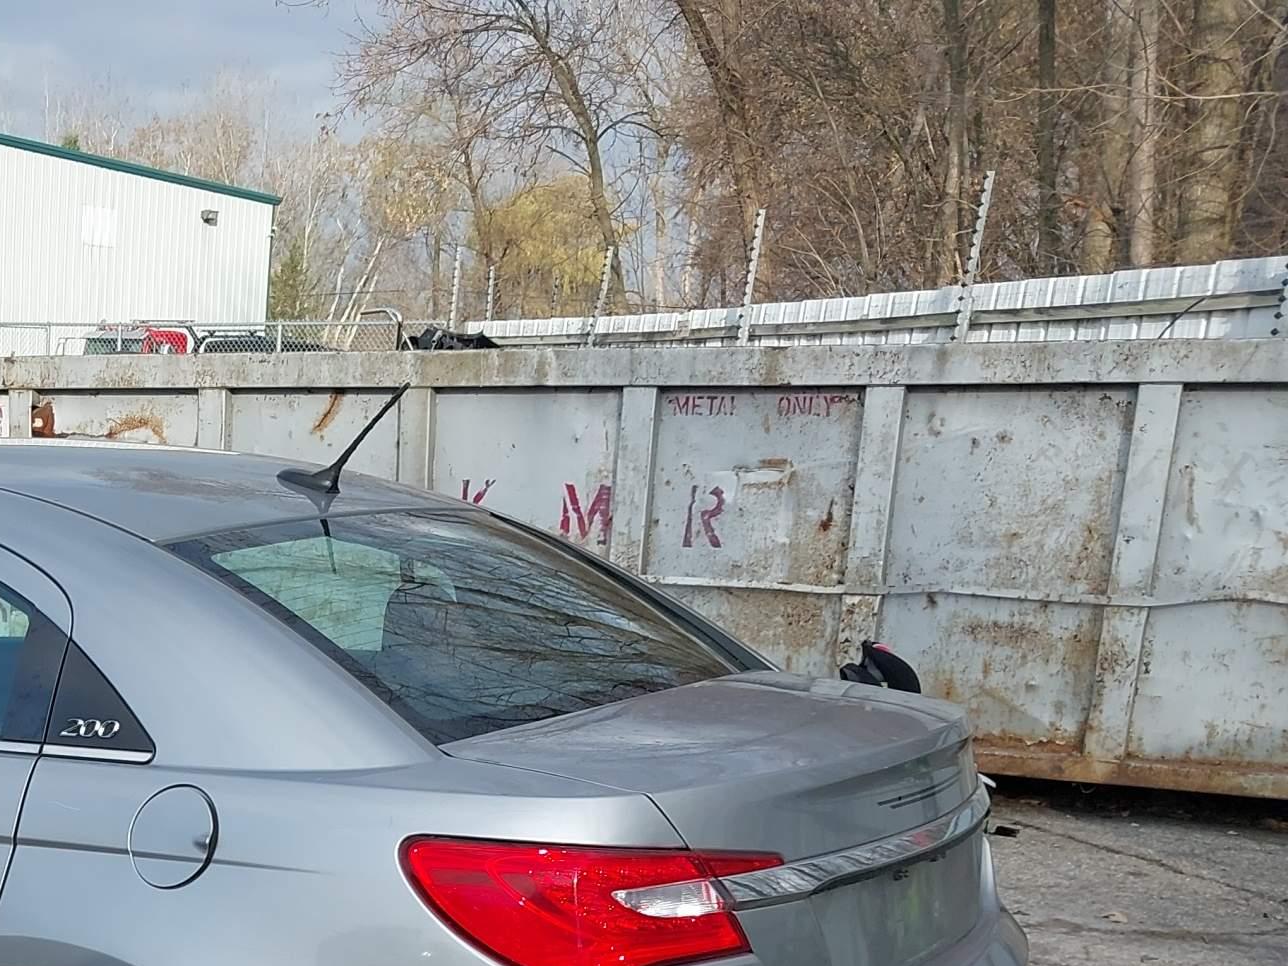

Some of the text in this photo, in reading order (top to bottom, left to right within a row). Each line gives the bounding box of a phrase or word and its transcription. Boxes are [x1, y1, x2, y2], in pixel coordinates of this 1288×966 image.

[778, 396, 832, 417] ONLY
[560, 483, 612, 545] M
[682, 485, 725, 548] R
[59, 718, 120, 738] 200
